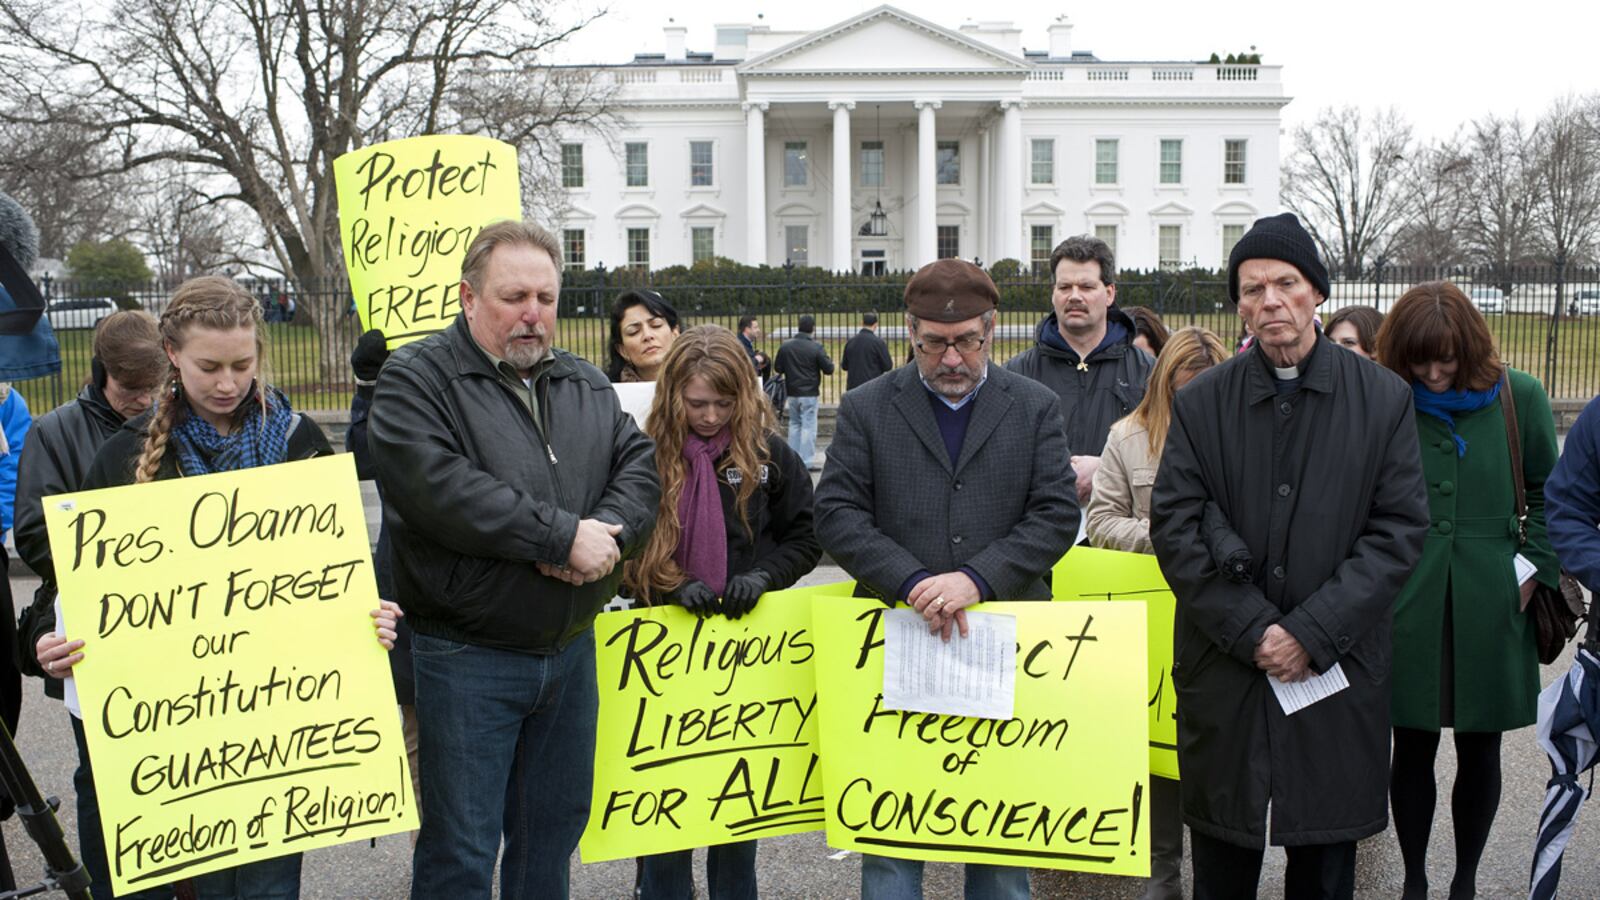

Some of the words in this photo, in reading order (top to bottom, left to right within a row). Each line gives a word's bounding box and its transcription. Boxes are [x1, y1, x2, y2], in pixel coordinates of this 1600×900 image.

[356, 149, 497, 211] Protect
[351, 217, 483, 278] Religio
[368, 281, 462, 330] FREE
[68, 509, 174, 572] Pres.
[189, 487, 345, 549] Obama,
[98, 582, 208, 639] DON'T
[224, 559, 365, 617] FORGET
[192, 630, 250, 659] our
[605, 617, 815, 697] Religious
[102, 666, 341, 739] Constitution
[626, 692, 818, 758] LIBERTY
[130, 717, 381, 795] GUARANTEES
[601, 788, 688, 831] FOR
[707, 753, 824, 821] ALL
[942, 750, 980, 775] of
[115, 814, 237, 878] Freedom
[246, 796, 276, 839] of
[284, 756, 405, 838] Religion!
[837, 778, 1143, 856] CONSCIENCE!
